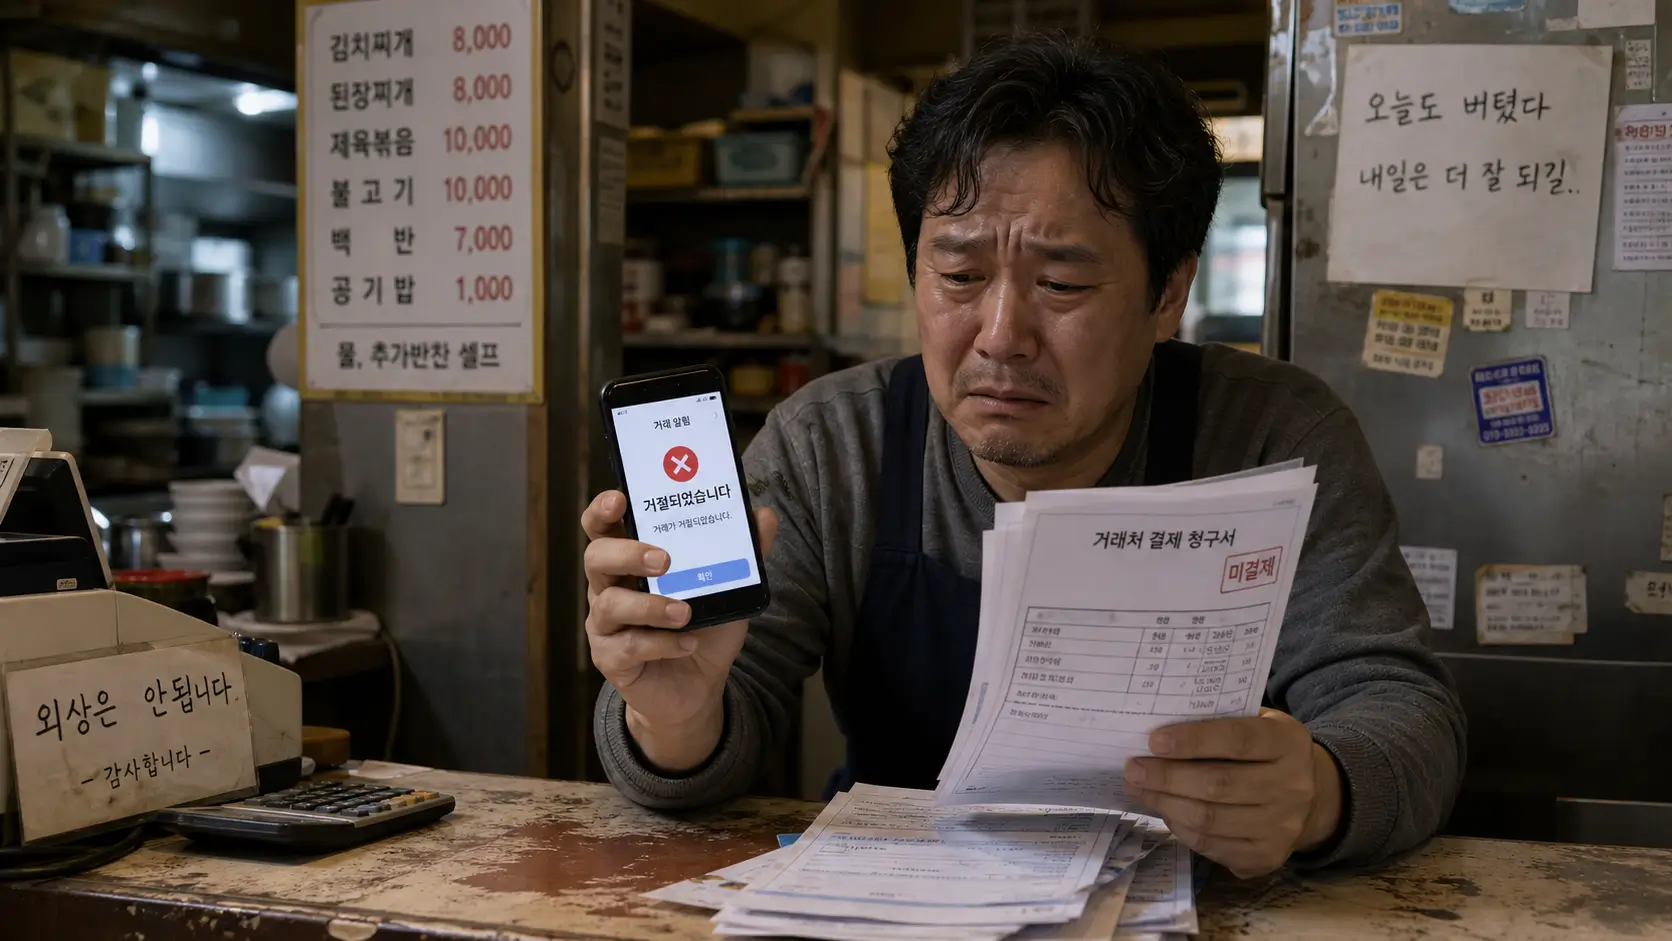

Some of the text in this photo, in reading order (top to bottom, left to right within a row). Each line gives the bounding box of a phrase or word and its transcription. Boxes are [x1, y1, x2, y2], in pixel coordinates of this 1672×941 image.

[329, 23, 513, 62] 김치찌개 8,000
[329, 73, 513, 112] 된장찌개 8,000
[1364, 88, 1552, 126] 오늘도 버텼다
[329, 123, 513, 159] 제육볶음 10,000
[443, 175, 513, 204] 10,000
[1359, 158, 1430, 194] 내일은
[1445, 163, 1468, 190] 더
[1481, 158, 1506, 193] 잘
[453, 225, 513, 254] 7,000
[455, 275, 513, 303] 1,000
[369, 341, 451, 369] 추가반찬
[458, 340, 500, 368] 셀프
[653, 415, 691, 431] 거래 알림
[643, 483, 732, 513] 거절되었습니다
[1092, 528, 1237, 550] 거래처 결제 청구서
[1227, 555, 1277, 583] 미결제
[35, 688, 118, 742] 외상은
[103, 744, 193, 790] 감사합니다
